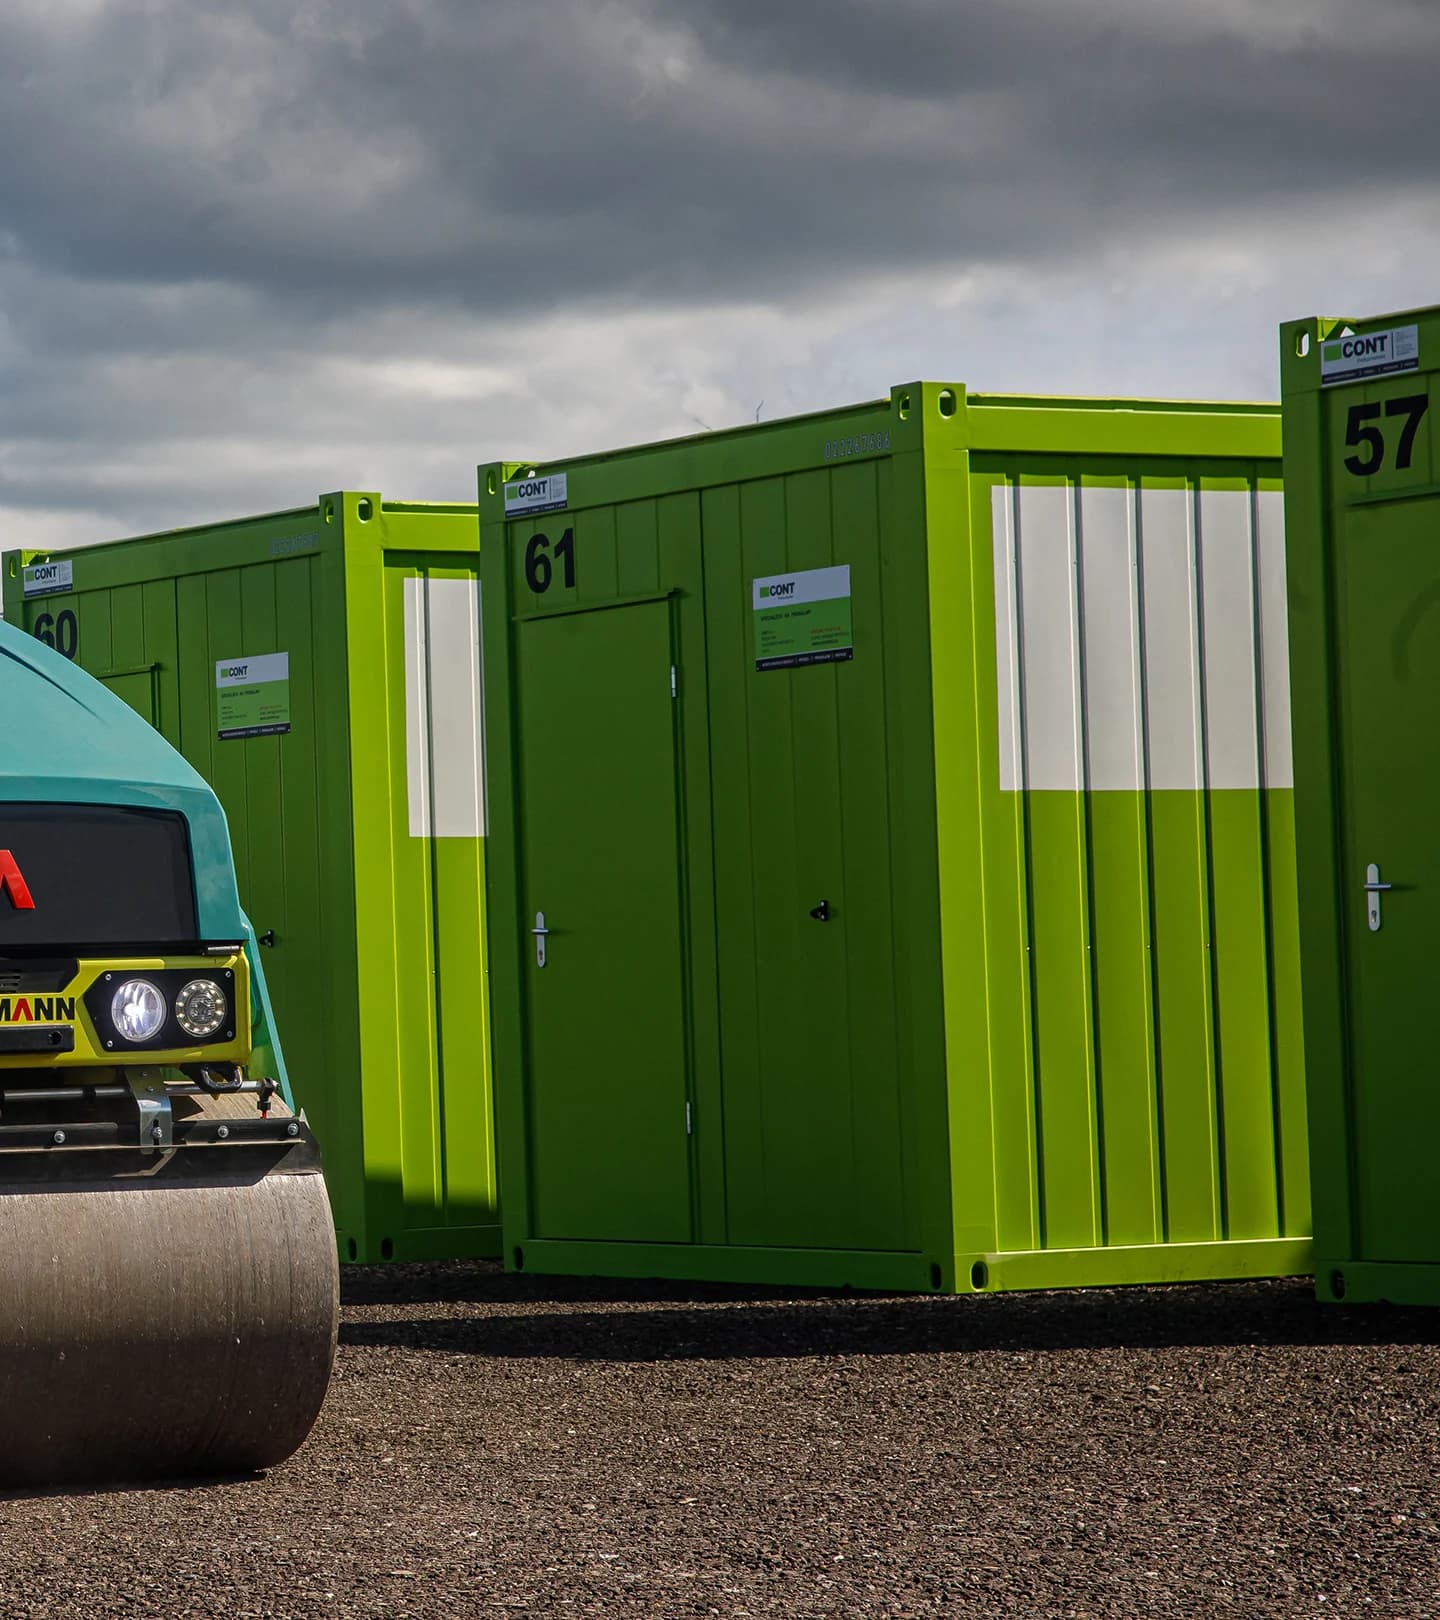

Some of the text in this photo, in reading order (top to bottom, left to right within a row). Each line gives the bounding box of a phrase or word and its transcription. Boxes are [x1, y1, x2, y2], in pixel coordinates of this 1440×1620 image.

[1342, 335, 1388, 358] CONT
[1344, 393, 1429, 476] 57
[518, 480, 548, 498] CONT
[525, 527, 575, 594] 61
[34, 566, 58, 580] CONT
[769, 582, 795, 597] CONT
[34, 609, 78, 660] 60
[229, 665, 248, 677] CONT
